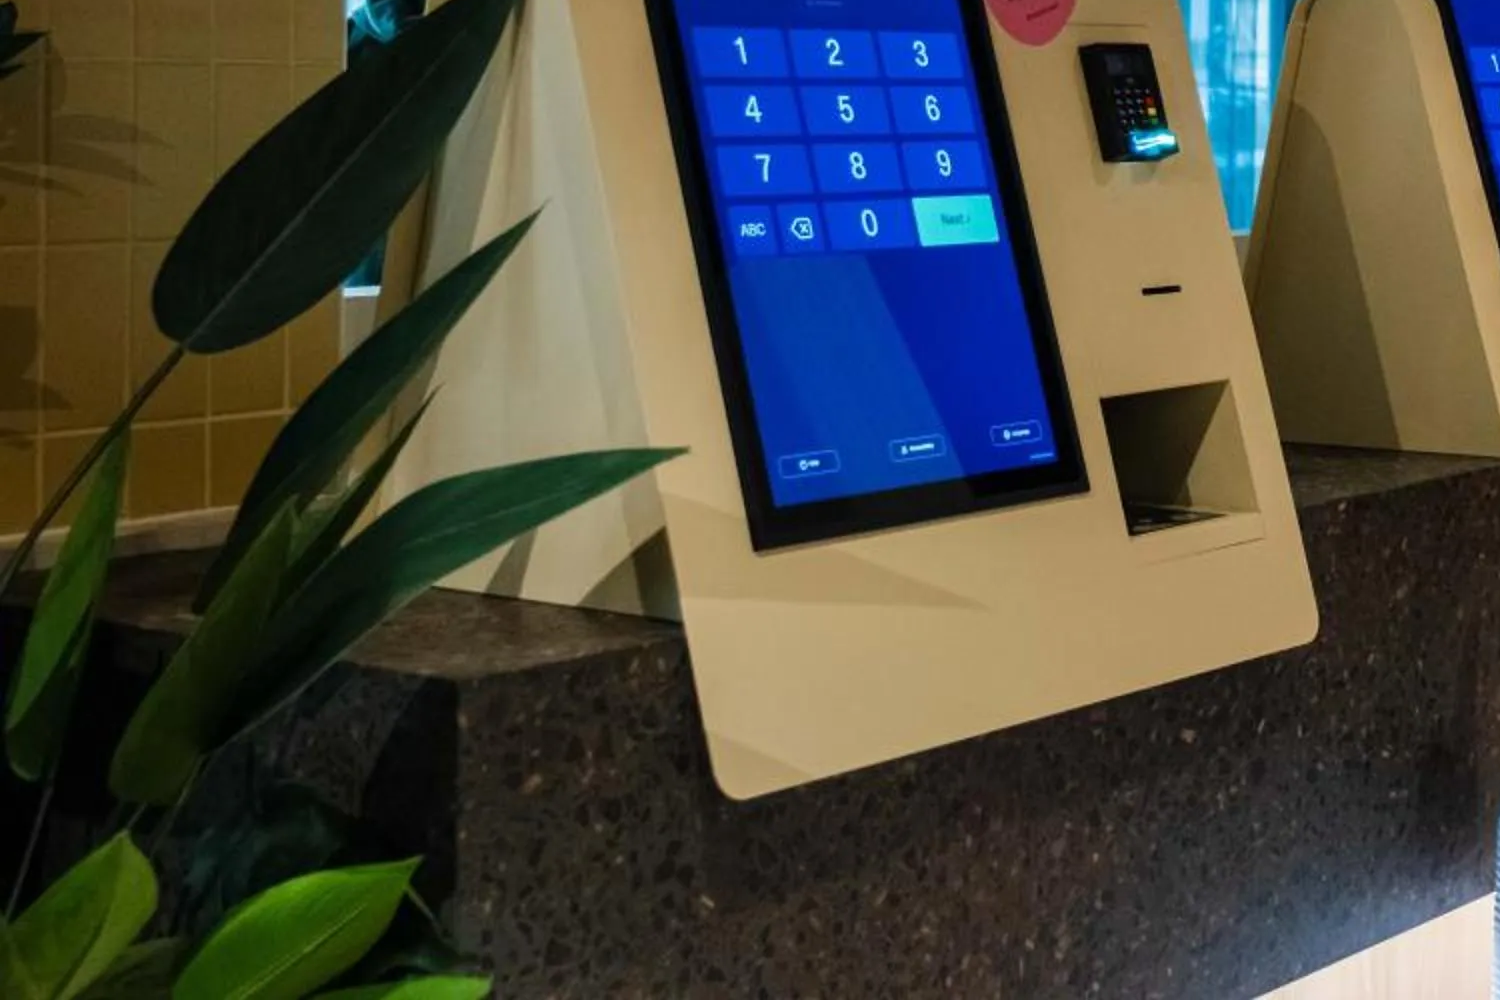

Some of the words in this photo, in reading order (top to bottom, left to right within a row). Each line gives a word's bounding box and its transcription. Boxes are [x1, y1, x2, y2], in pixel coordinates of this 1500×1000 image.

[734, 36, 748, 65] 1
[825, 37, 844, 66] 2
[912, 39, 929, 68] 3
[1490, 53, 1500, 73] 1
[744, 95, 763, 123] 4
[836, 94, 855, 124] 5
[924, 94, 941, 122] 6
[753, 153, 771, 183] 7
[848, 151, 867, 180] 8
[935, 149, 952, 177] 9
[740, 222, 767, 237] ABC
[860, 208, 879, 238] 0
